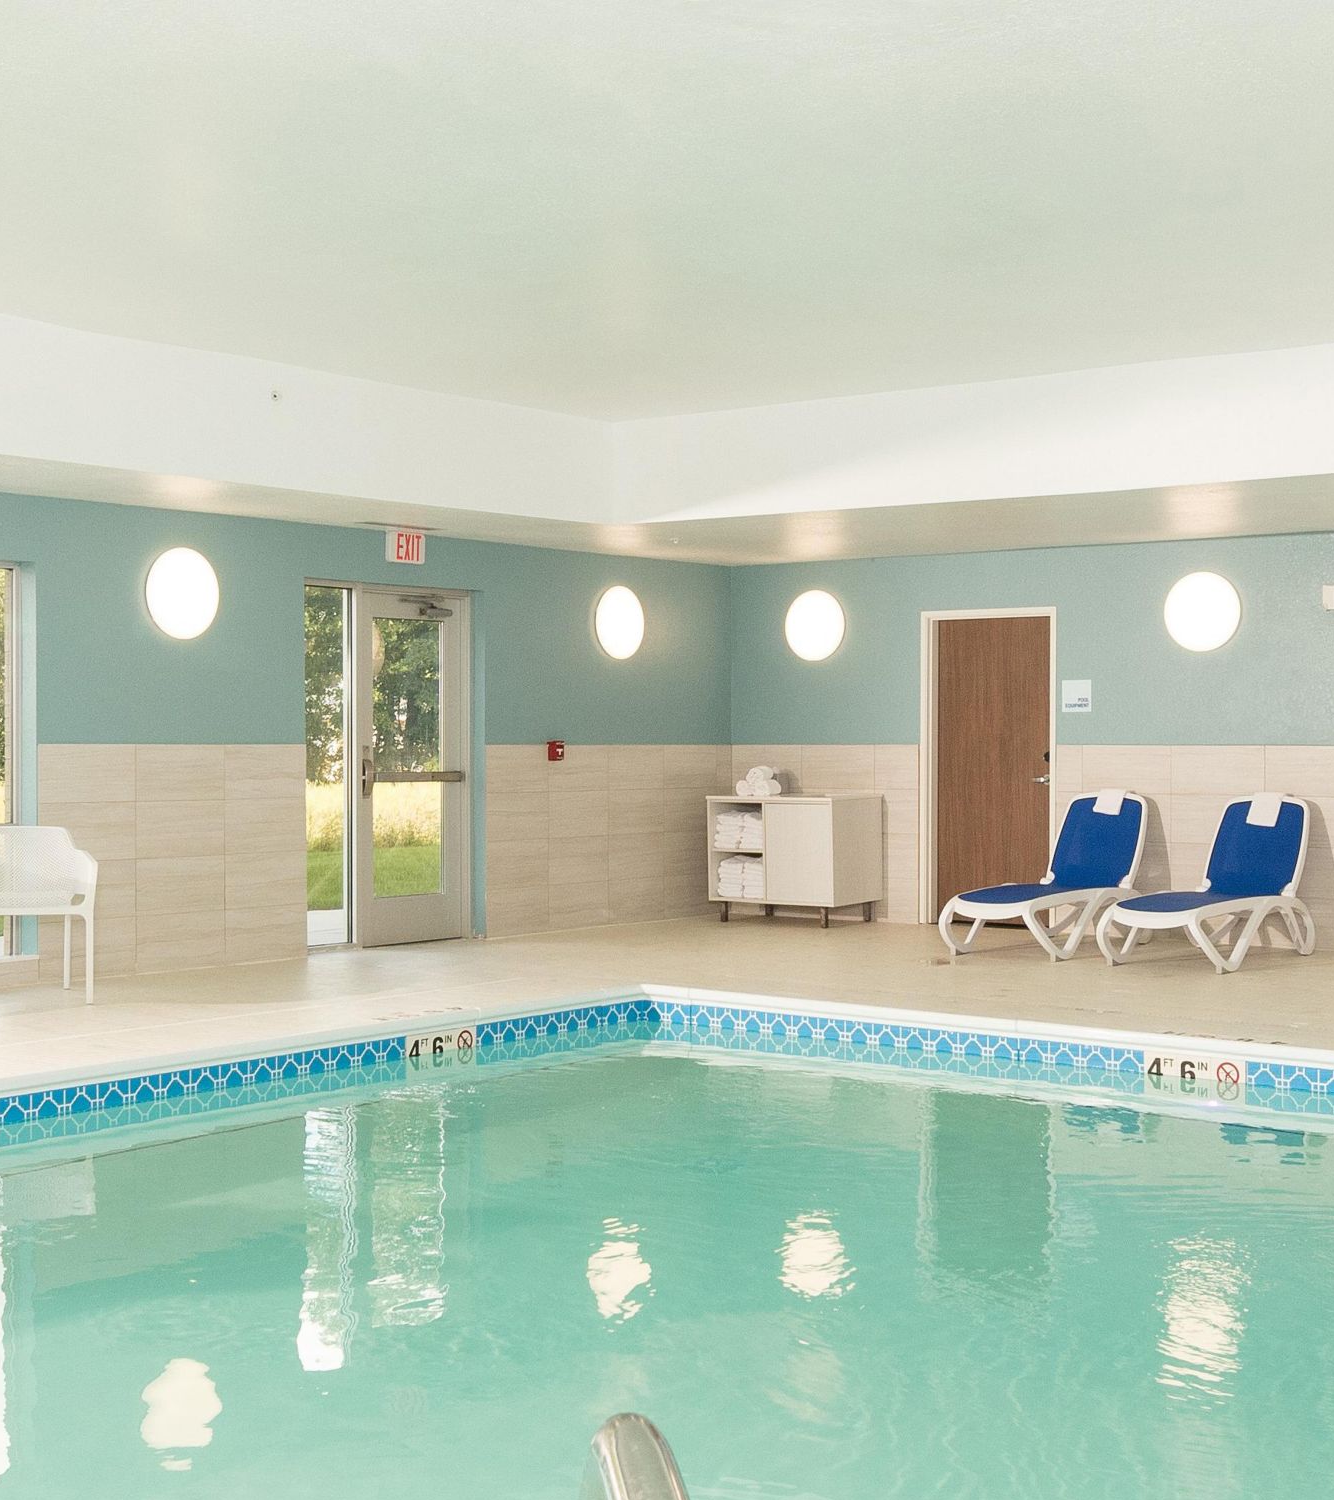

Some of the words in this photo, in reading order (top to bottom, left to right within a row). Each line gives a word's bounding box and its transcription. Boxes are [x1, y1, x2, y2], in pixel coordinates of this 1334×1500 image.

[396, 533, 422, 562] EXIT
[409, 1039, 421, 1057] 4
[432, 1036, 444, 1054] 6
[1147, 1057, 1164, 1076] 4
[1163, 1058, 1174, 1068] FT
[1180, 1060, 1196, 1080] 6
[1197, 1062, 1208, 1072] IN
